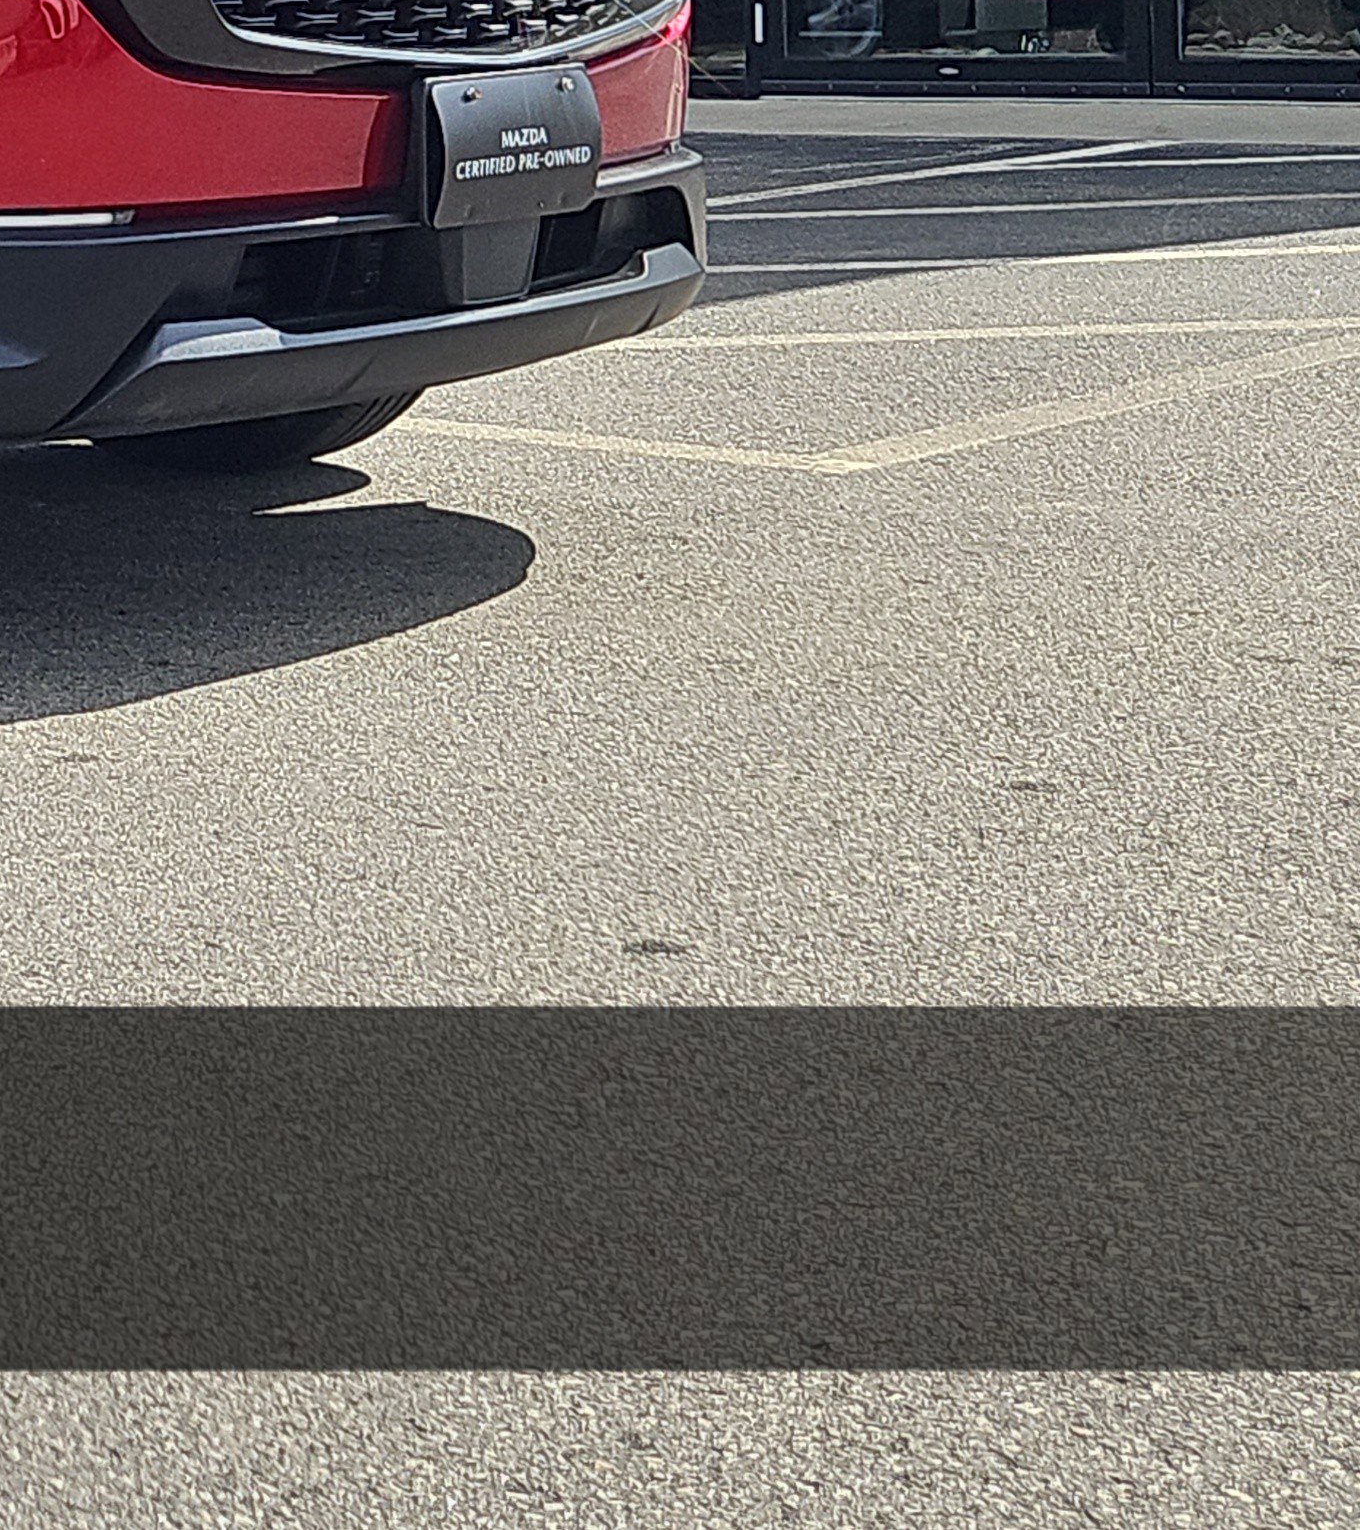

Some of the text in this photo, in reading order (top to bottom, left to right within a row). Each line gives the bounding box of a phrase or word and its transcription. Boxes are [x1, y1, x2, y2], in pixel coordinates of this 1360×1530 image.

[501, 127, 548, 148] MAZDA
[456, 145, 591, 180] CERTIFIED PRE-OWNED
